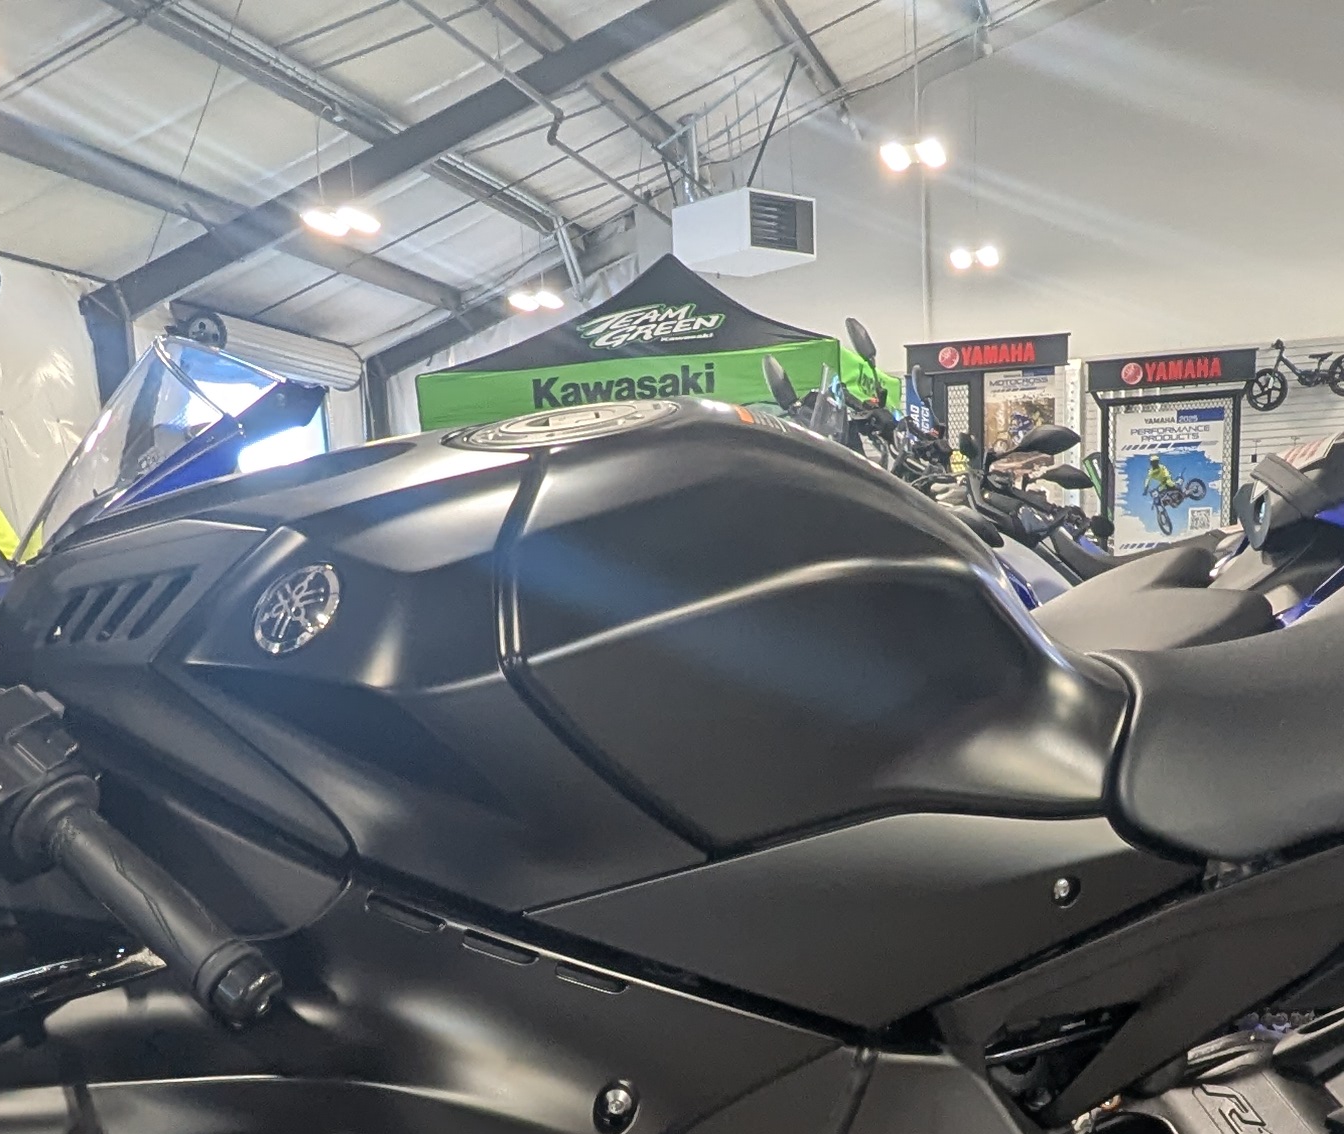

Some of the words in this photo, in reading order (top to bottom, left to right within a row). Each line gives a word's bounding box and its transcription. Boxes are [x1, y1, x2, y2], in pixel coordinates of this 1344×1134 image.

[578, 303, 693, 337] TEAM
[592, 313, 723, 349] GREEN
[660, 332, 714, 343] Kawasaki
[961, 340, 1036, 367] YAMAHA
[1144, 356, 1223, 383] YAMAHA
[531, 361, 716, 410] Kawasaki
[1130, 424, 1211, 437] PERFORMANCE
[1144, 416, 1176, 425] YAMAHA
[1140, 432, 1201, 443] PRODUCTS
